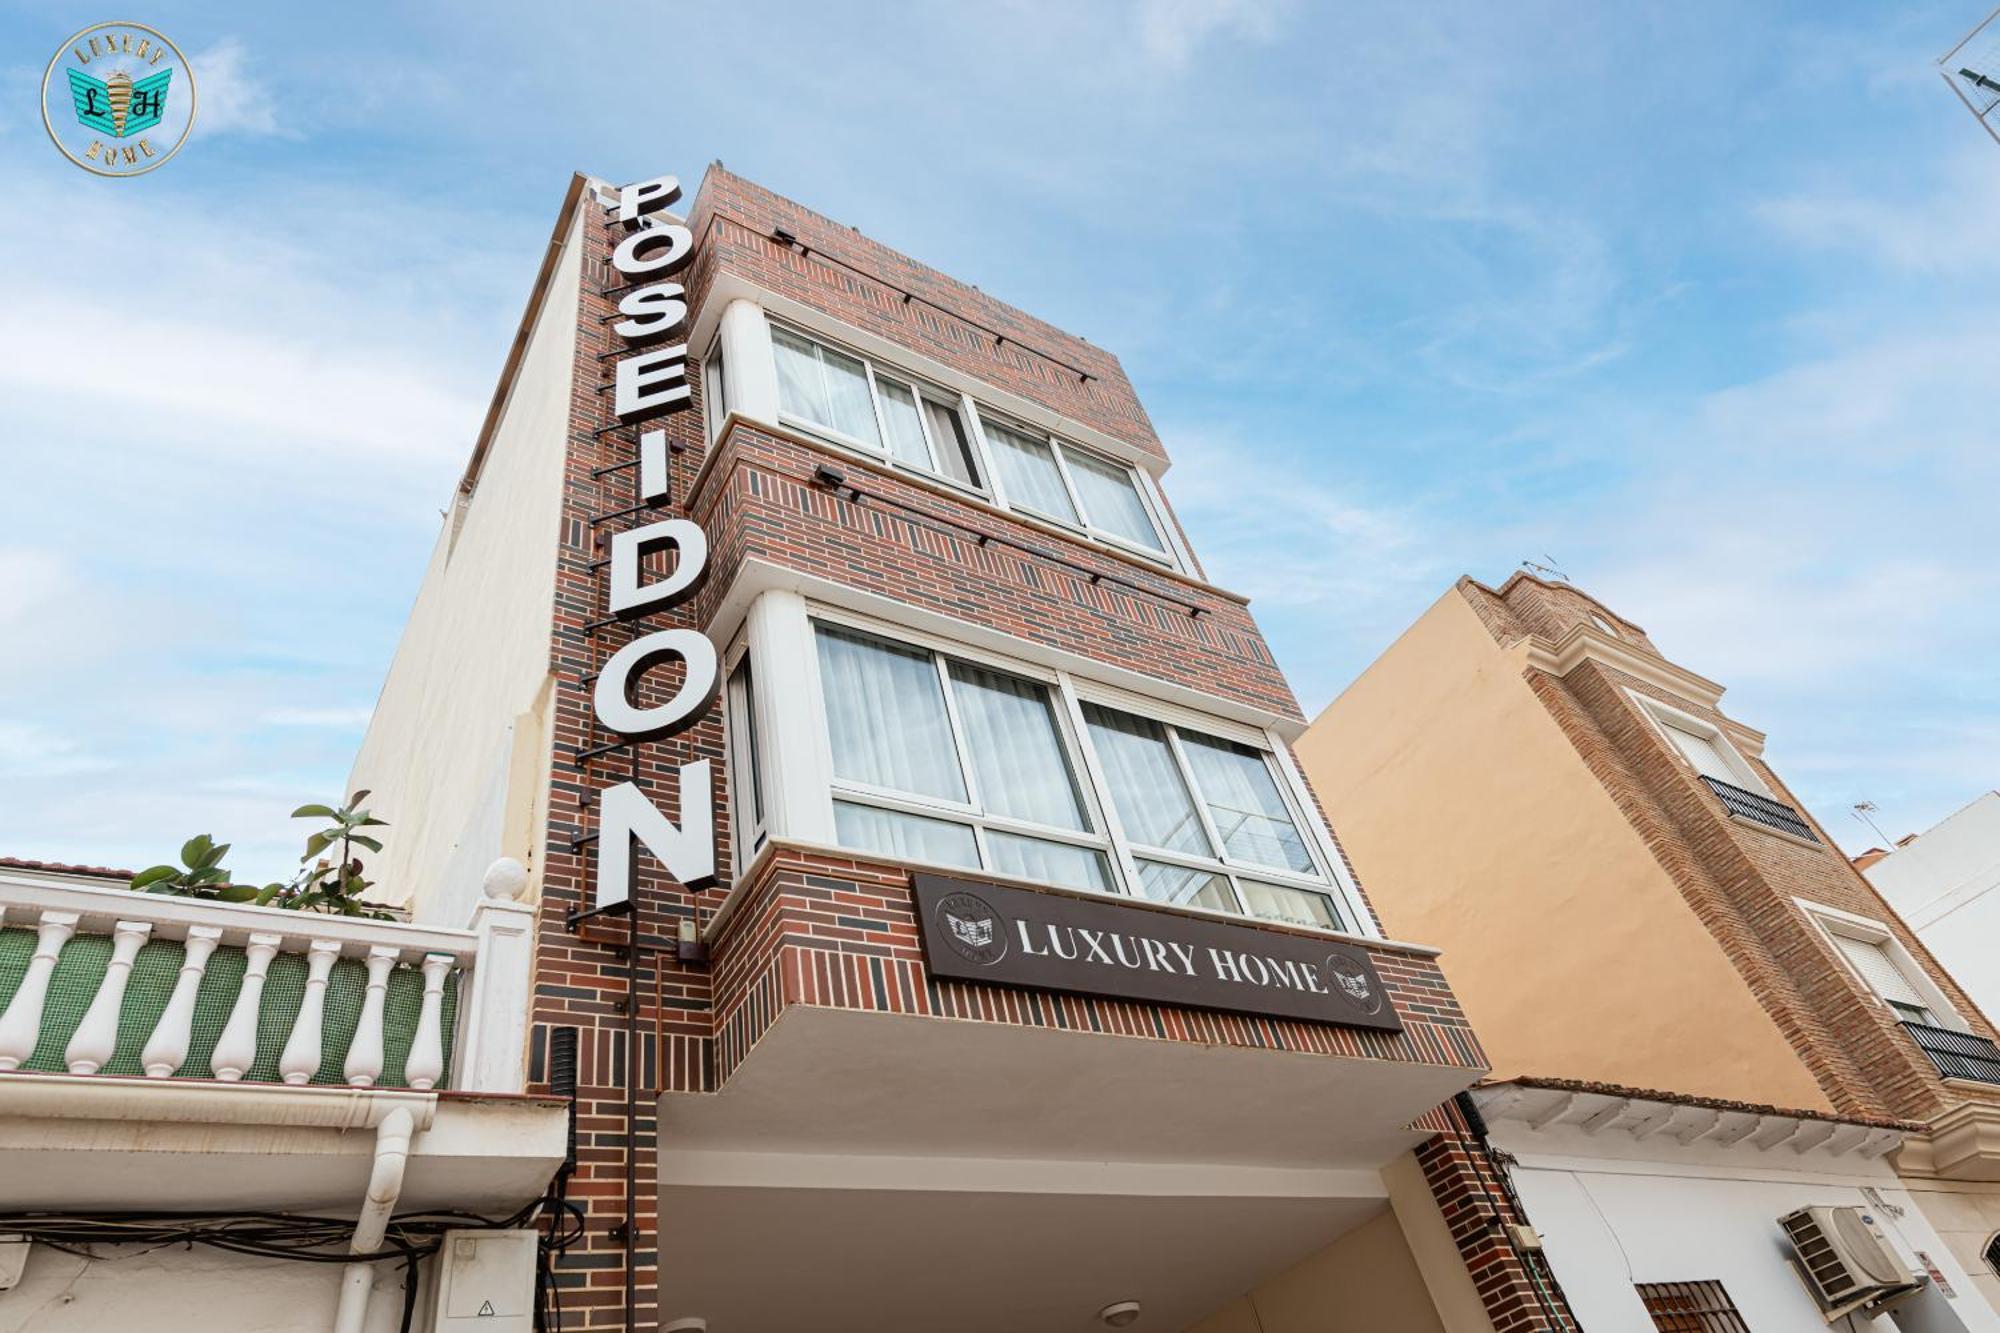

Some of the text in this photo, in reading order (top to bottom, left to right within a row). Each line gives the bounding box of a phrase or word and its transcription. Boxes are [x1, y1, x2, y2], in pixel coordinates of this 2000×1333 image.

[594, 174, 718, 911] POSEIDON
[1016, 919, 1329, 994] LUXURY HOME
